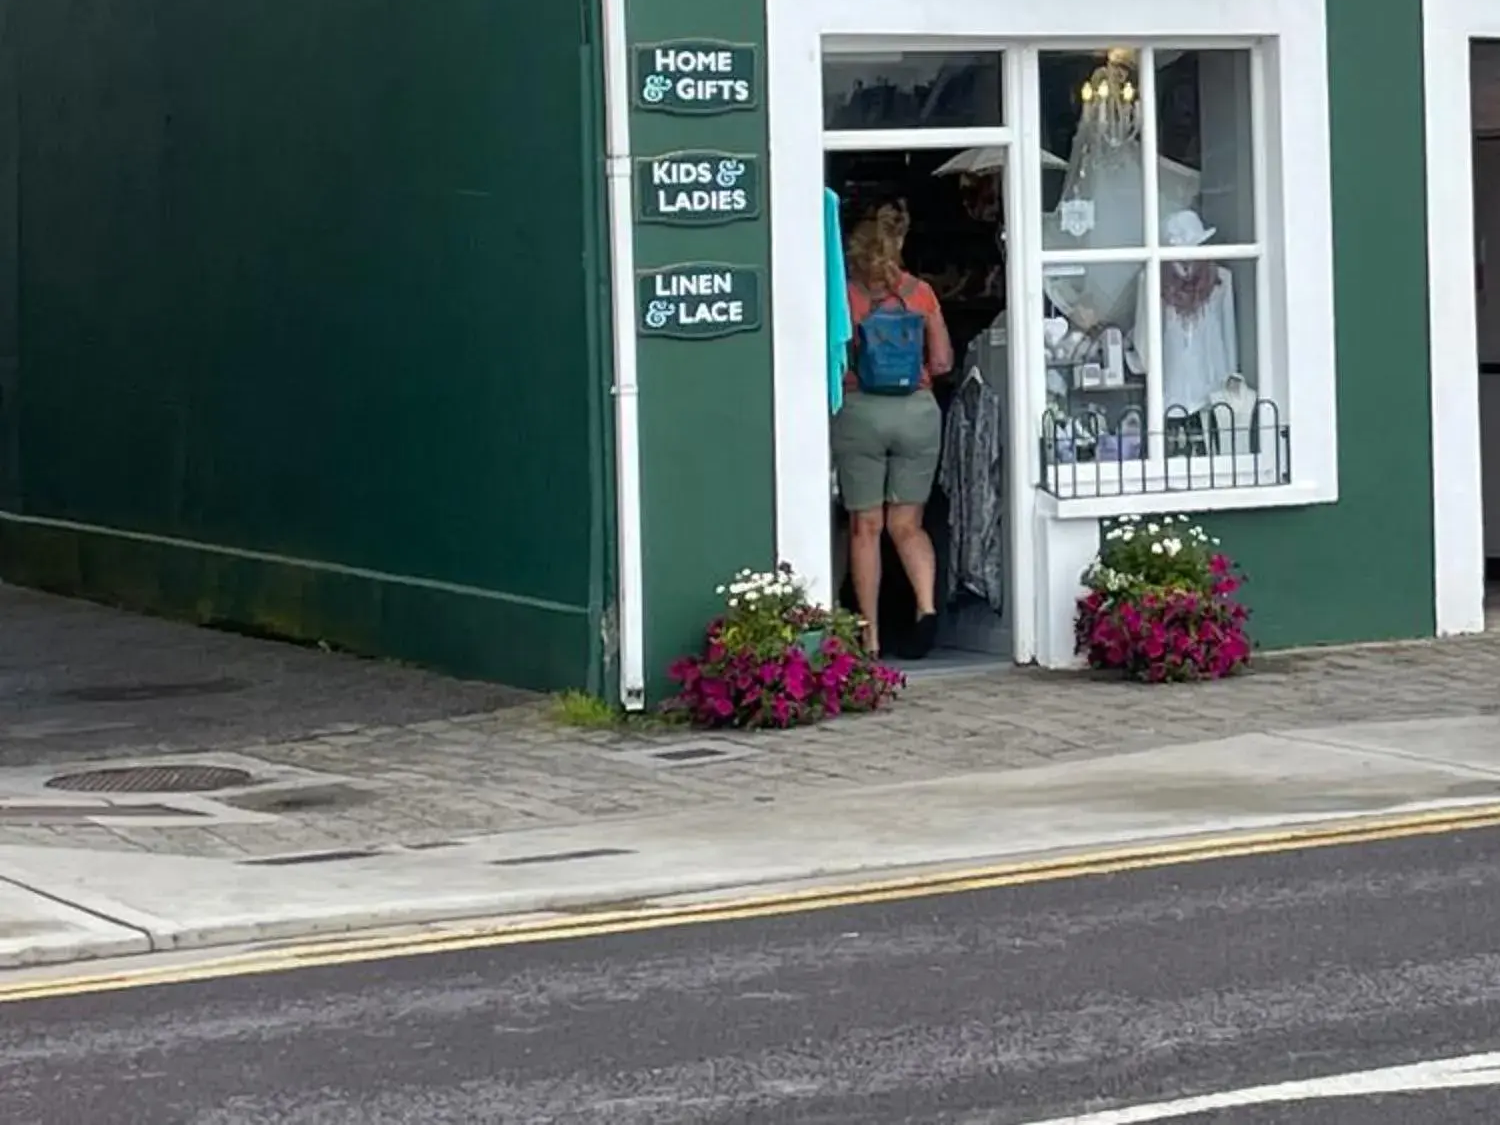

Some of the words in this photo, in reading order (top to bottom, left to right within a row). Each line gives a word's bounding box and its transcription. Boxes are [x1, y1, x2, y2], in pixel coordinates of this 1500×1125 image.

[655, 49, 732, 72] HOME
[643, 74, 672, 102] &
[676, 78, 749, 101] GIFTS
[653, 161, 712, 184] KIDS
[716, 159, 745, 187] &
[658, 190, 747, 212] LADIES
[655, 273, 732, 296] LINEN
[646, 299, 675, 328] &
[679, 301, 743, 324] LACE
